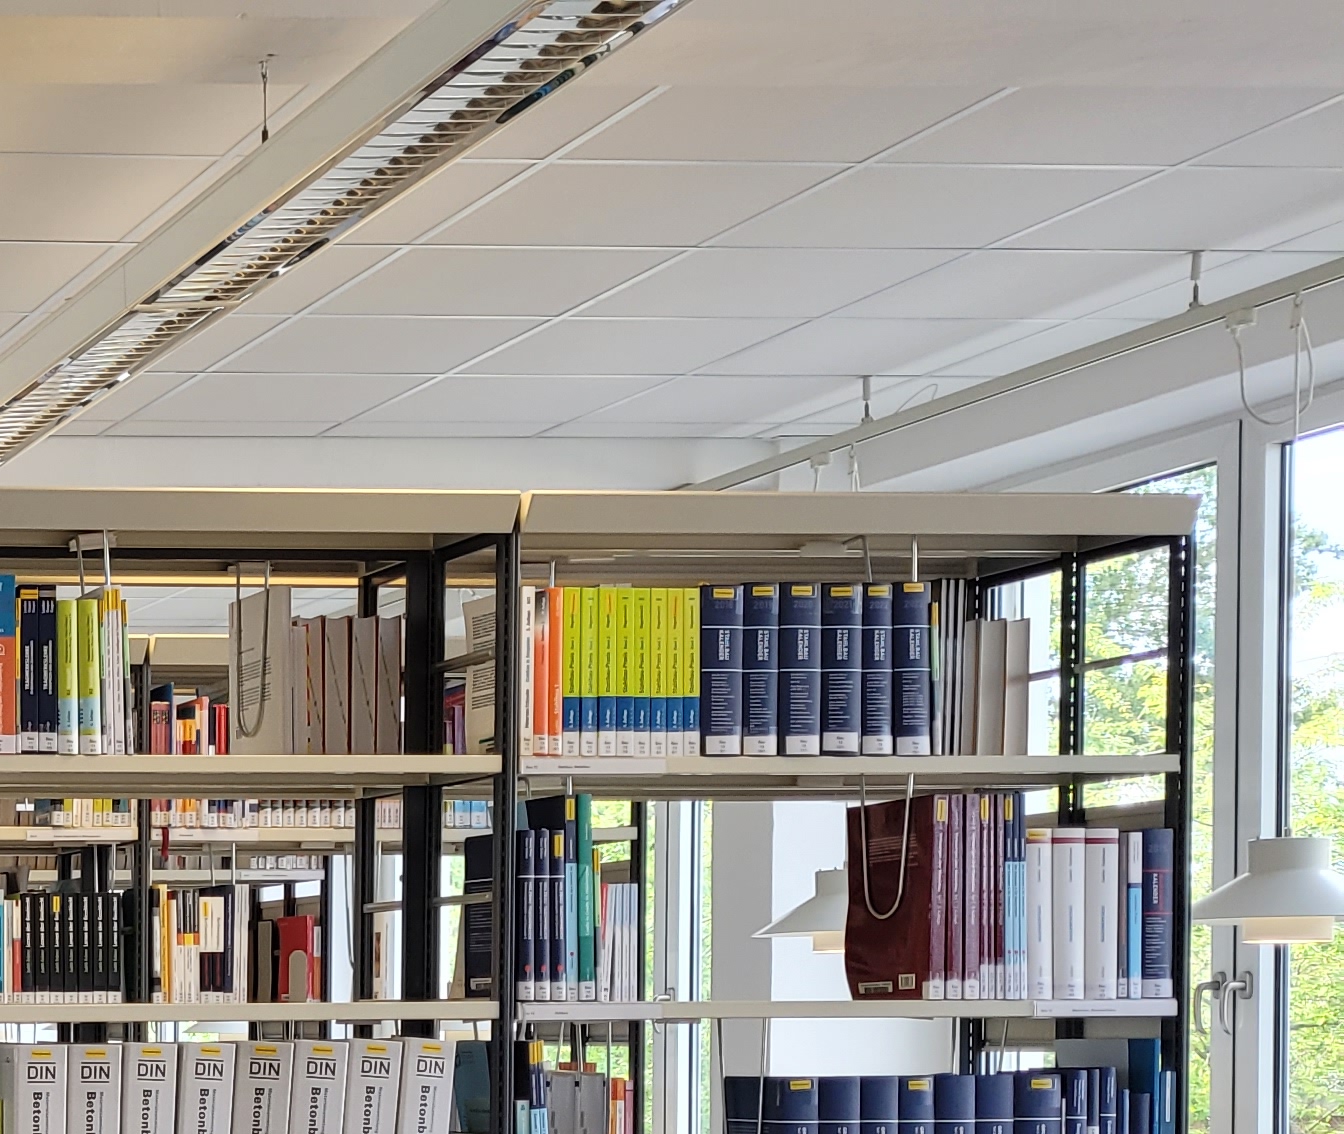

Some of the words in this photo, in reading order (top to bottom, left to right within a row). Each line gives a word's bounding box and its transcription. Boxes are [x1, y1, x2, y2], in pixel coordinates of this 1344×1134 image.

[27, 1066, 56, 1079] DIN
[81, 1066, 110, 1080] DIN
[137, 1063, 166, 1078] DIN
[194, 1062, 224, 1077] DIN
[249, 1061, 281, 1076] DIN
[306, 1061, 336, 1076] DIN
[361, 1060, 390, 1075] DIN
[416, 1059, 445, 1075] DIN
